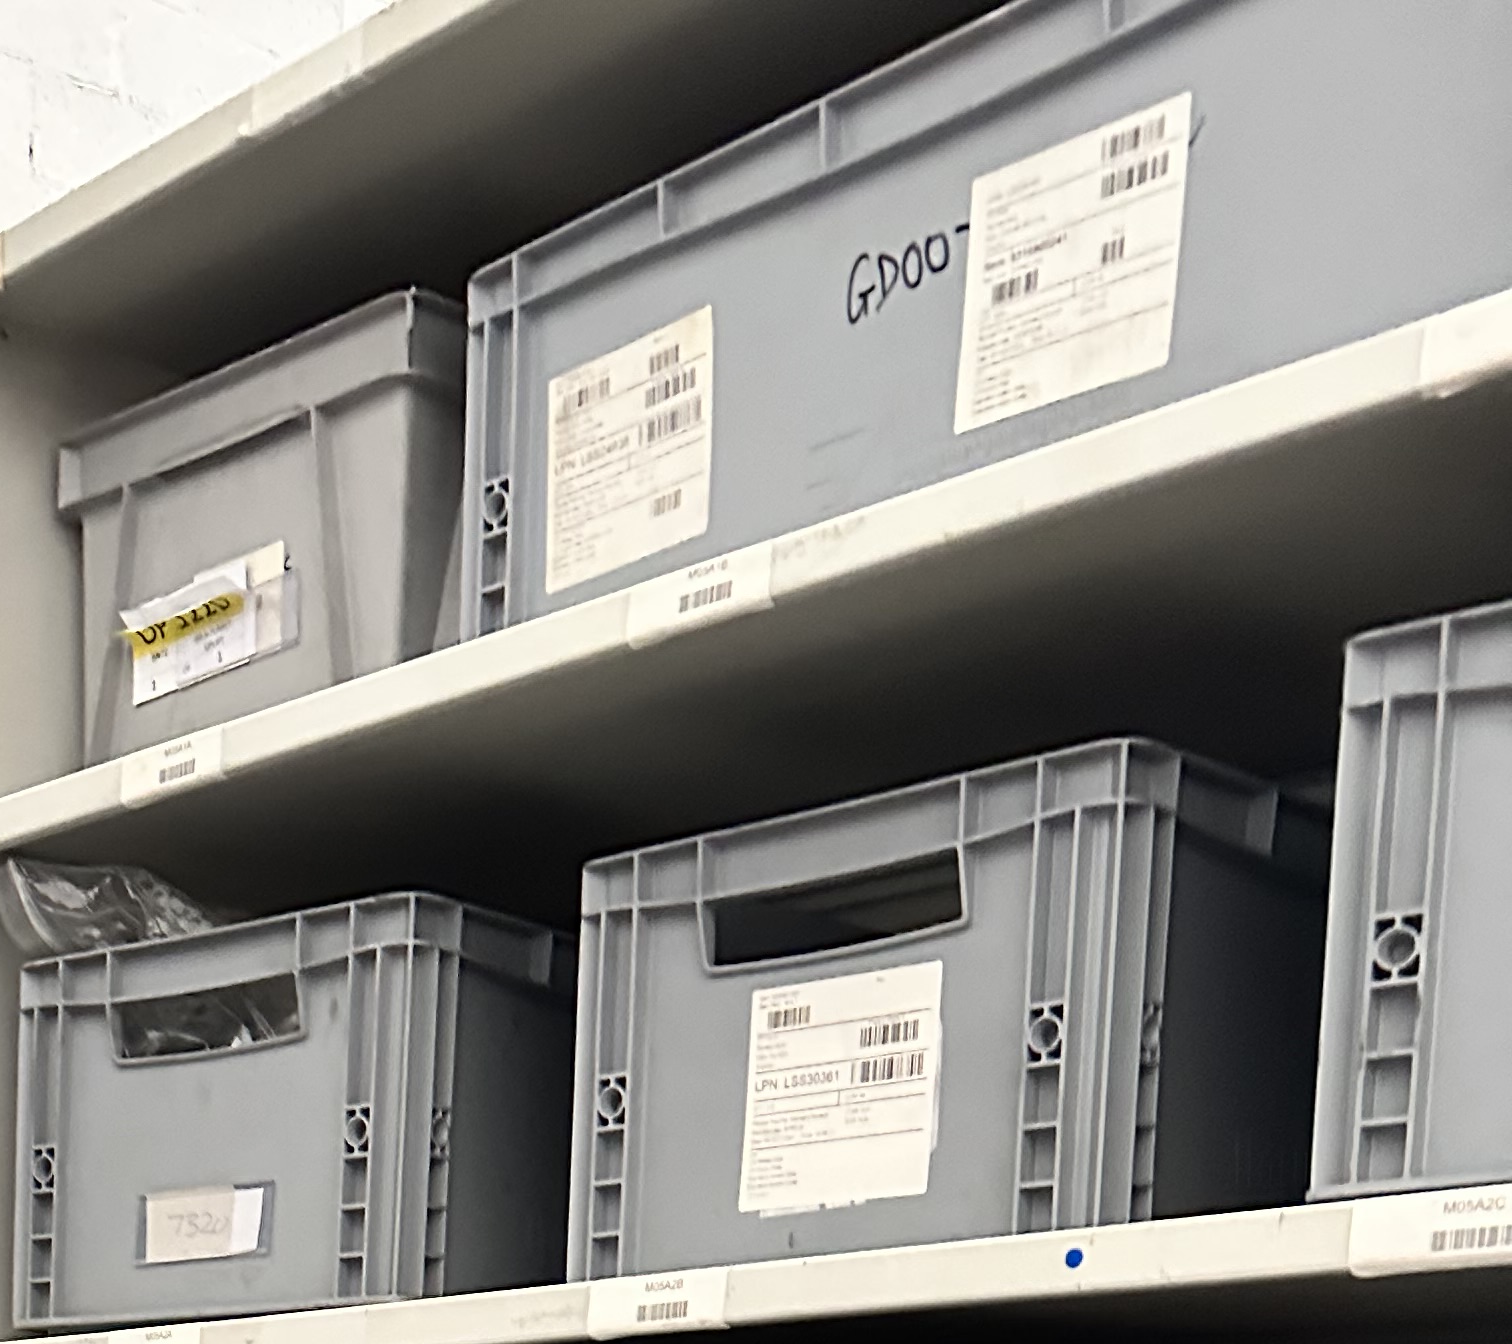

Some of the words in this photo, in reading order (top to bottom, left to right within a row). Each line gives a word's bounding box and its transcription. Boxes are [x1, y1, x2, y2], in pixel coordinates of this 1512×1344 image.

[754, 1075, 778, 1093] LPN
[1443, 1196, 1507, 1215] M05A2C
[167, 1211, 230, 1239] 7320
